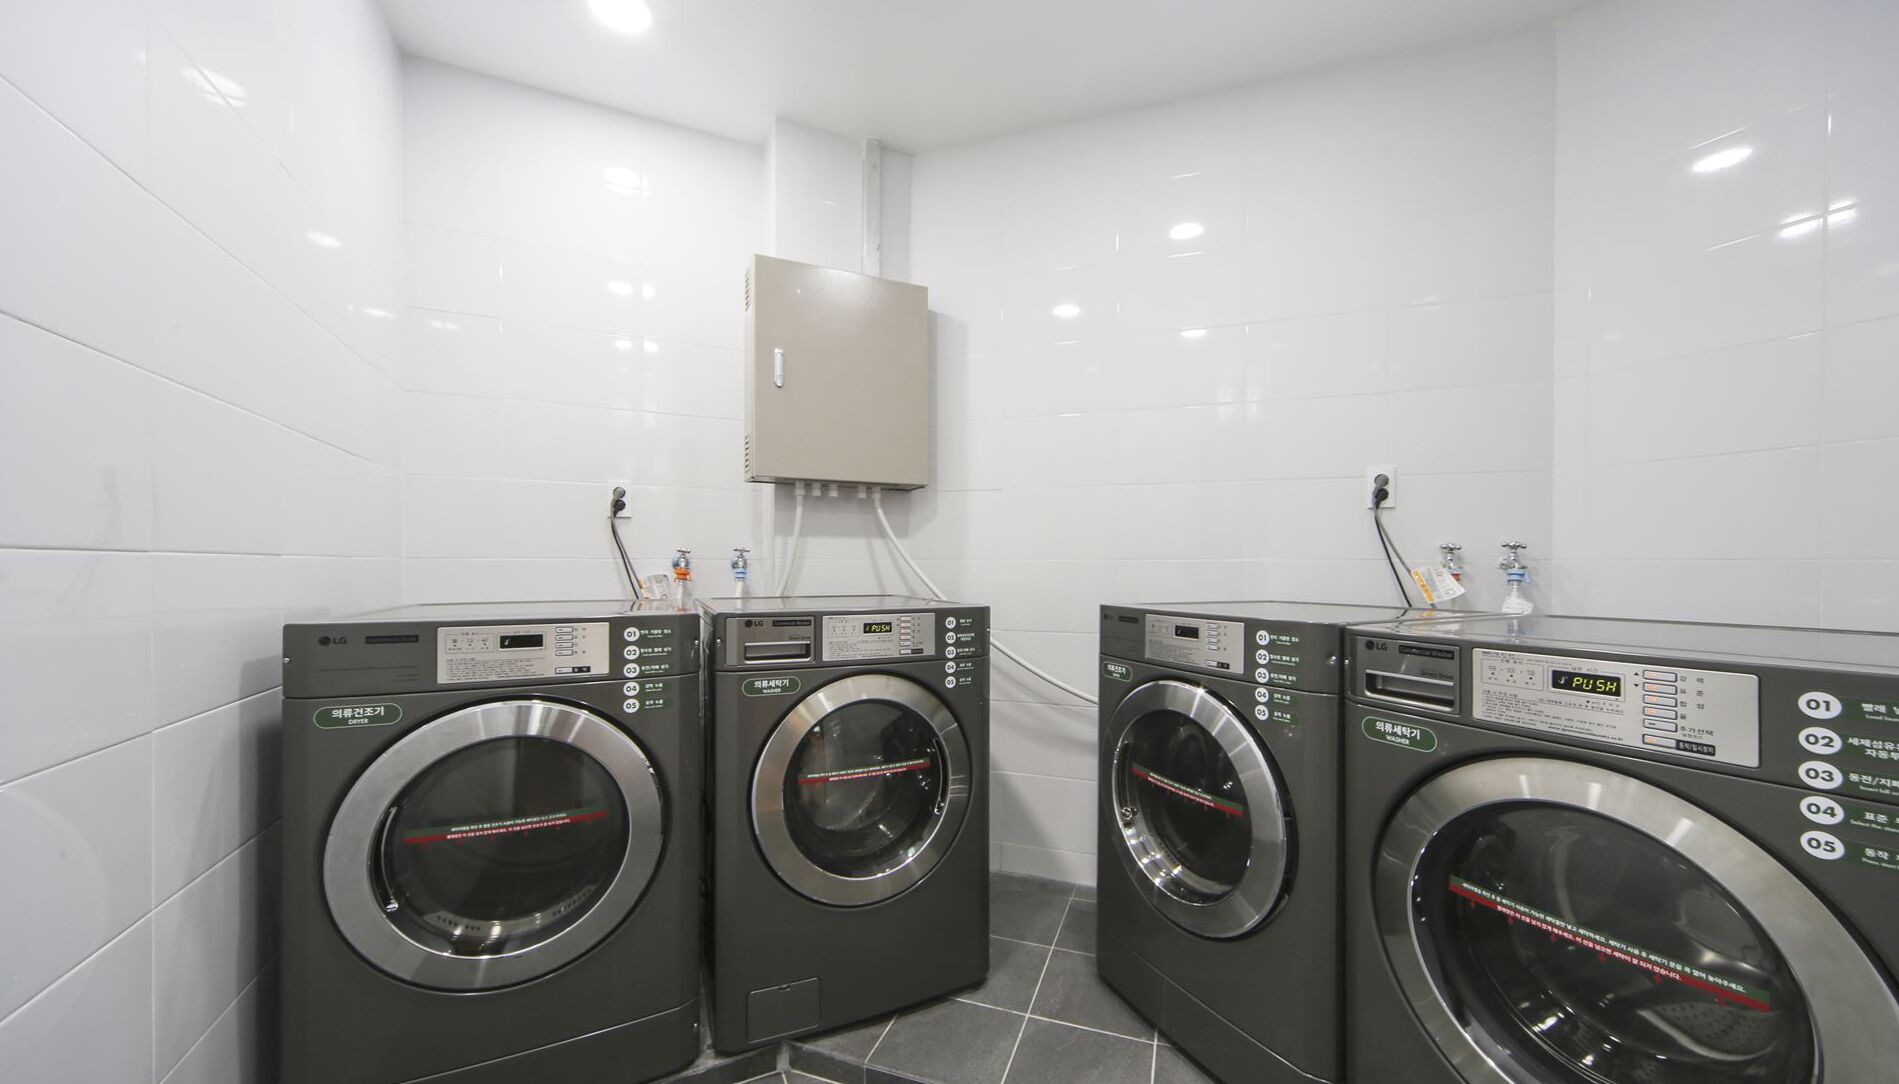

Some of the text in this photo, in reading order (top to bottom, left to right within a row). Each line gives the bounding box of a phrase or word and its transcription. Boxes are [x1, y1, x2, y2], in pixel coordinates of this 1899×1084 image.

[871, 624, 891, 632] PUSH
[1572, 676, 1617, 692] PUSH
[332, 706, 385, 719] 의류건조기
[1806, 698, 1831, 712] 01
[1375, 721, 1420, 740] 의류세탁기
[1385, 735, 1410, 745] WASHER
[1805, 733, 1835, 748] 02
[1805, 767, 1835, 783] 03
[1806, 802, 1838, 818] 04
[1807, 837, 1837, 853] 05
